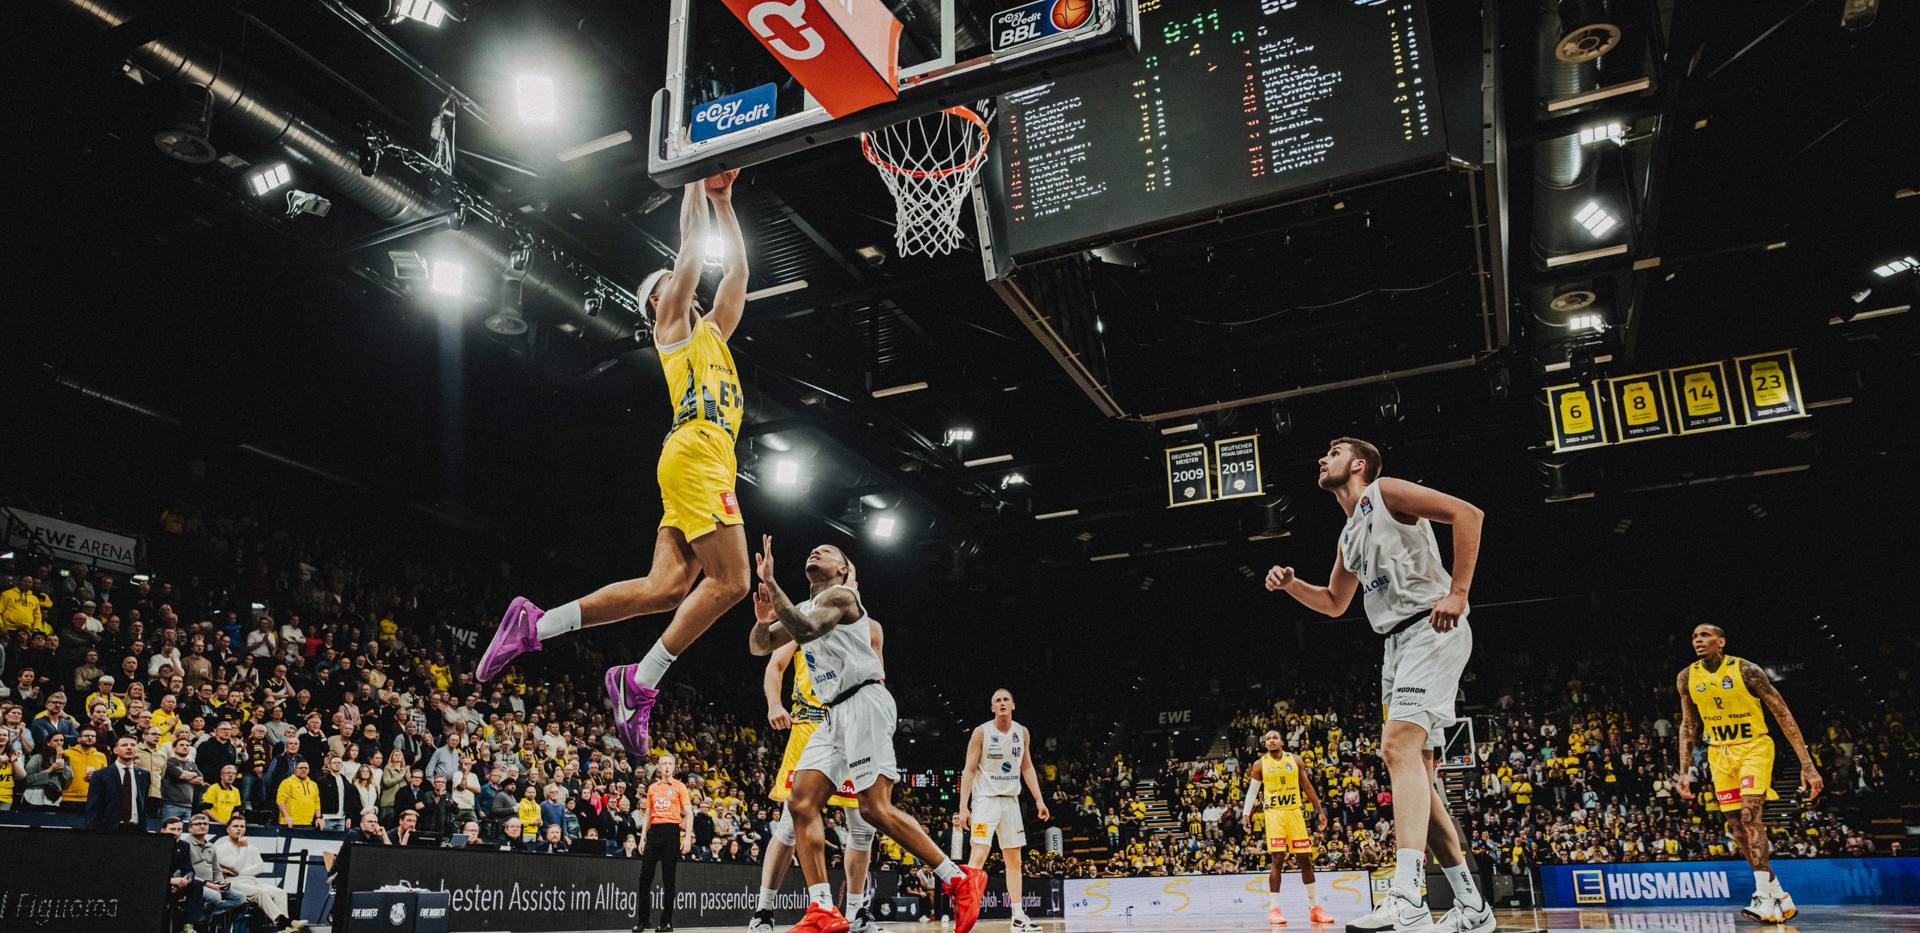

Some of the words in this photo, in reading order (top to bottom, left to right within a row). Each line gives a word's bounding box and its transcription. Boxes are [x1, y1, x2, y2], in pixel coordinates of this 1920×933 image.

[1000, 22, 1041, 47] BBL
[717, 103, 770, 131] Credit
[1755, 374, 1782, 392] 23
[1688, 384, 1714, 402] 14
[1632, 396, 1647, 411] 8
[1570, 404, 1582, 419] 6
[1171, 450, 1202, 460] DEUTSCHER
[1221, 443, 1253, 452] DEUTSCHER
[1175, 457, 1199, 465] MEISTER
[1222, 460, 1255, 475] 2015
[1173, 468, 1204, 483] 2009
[35, 527, 77, 549] EWE
[79, 538, 133, 563] ARENA
[1158, 710, 1192, 724] EWE
[1270, 794, 1297, 806] EWE
[1607, 871, 1731, 900] HUSMANN
[508, 882, 566, 912] Assists
[571, 883, 591, 911] im
[594, 882, 638, 917] Alltag
